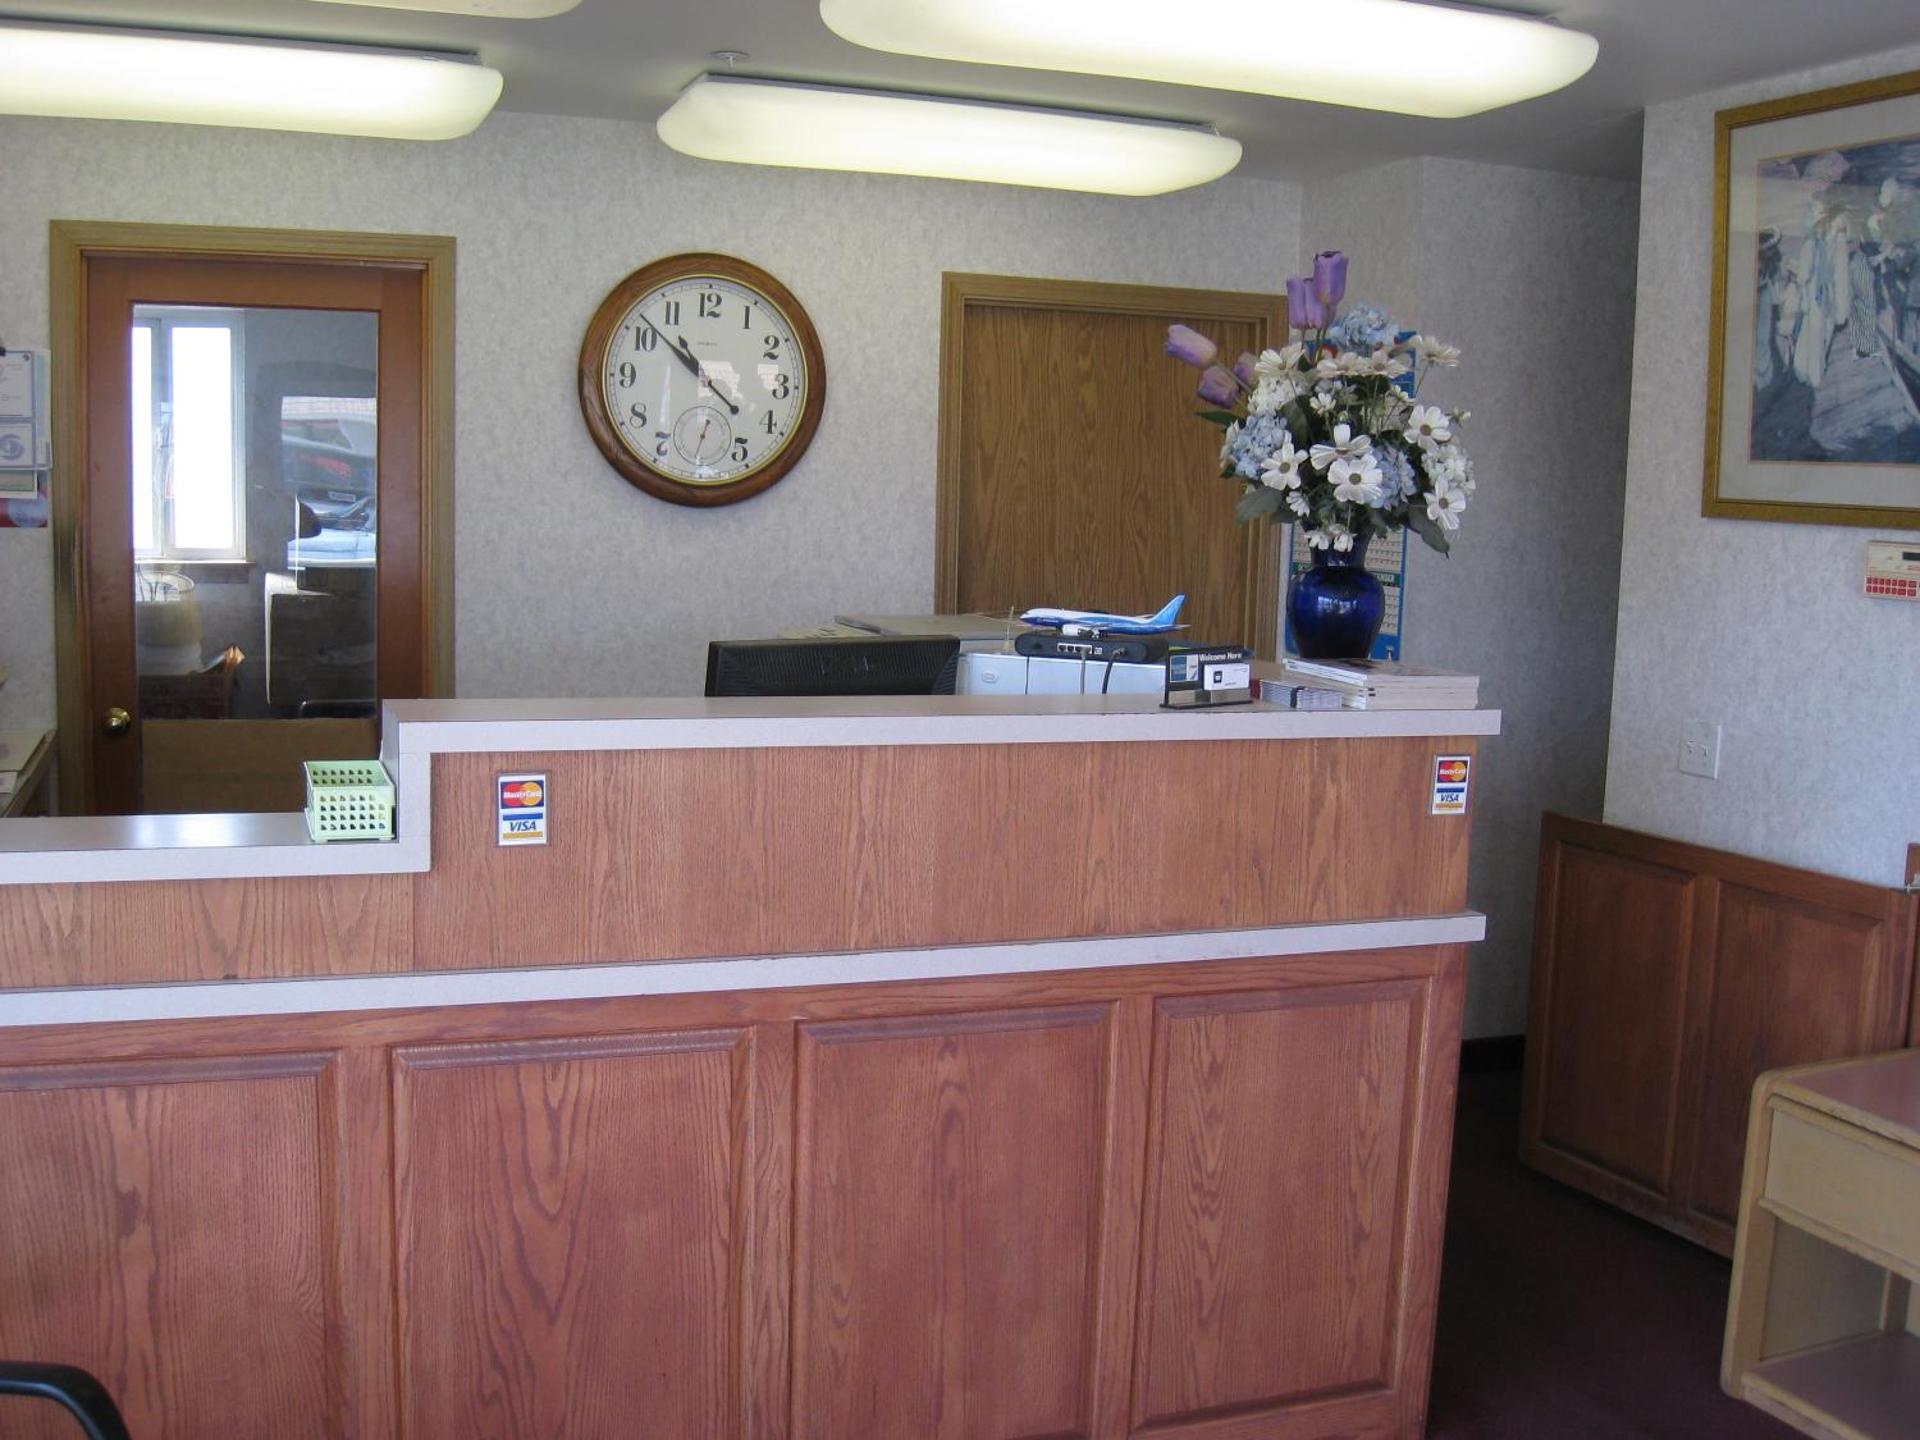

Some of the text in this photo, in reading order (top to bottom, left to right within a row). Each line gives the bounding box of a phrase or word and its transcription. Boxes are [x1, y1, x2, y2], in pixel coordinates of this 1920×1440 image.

[664, 301, 680, 326] 11
[699, 292, 723, 319] 12
[742, 305, 751, 330] 1
[634, 326, 657, 352] 10
[763, 335, 780, 360] 2
[619, 362, 637, 388] 9
[772, 373, 789, 400] 3
[629, 402, 647, 428] 8
[759, 410, 778, 435] 4
[655, 431, 671, 457] 7
[731, 437, 748, 462] 5
[1227, 651, 1242, 660] Here
[1441, 793, 1459, 802] VISA
[509, 821, 537, 832] VISA
